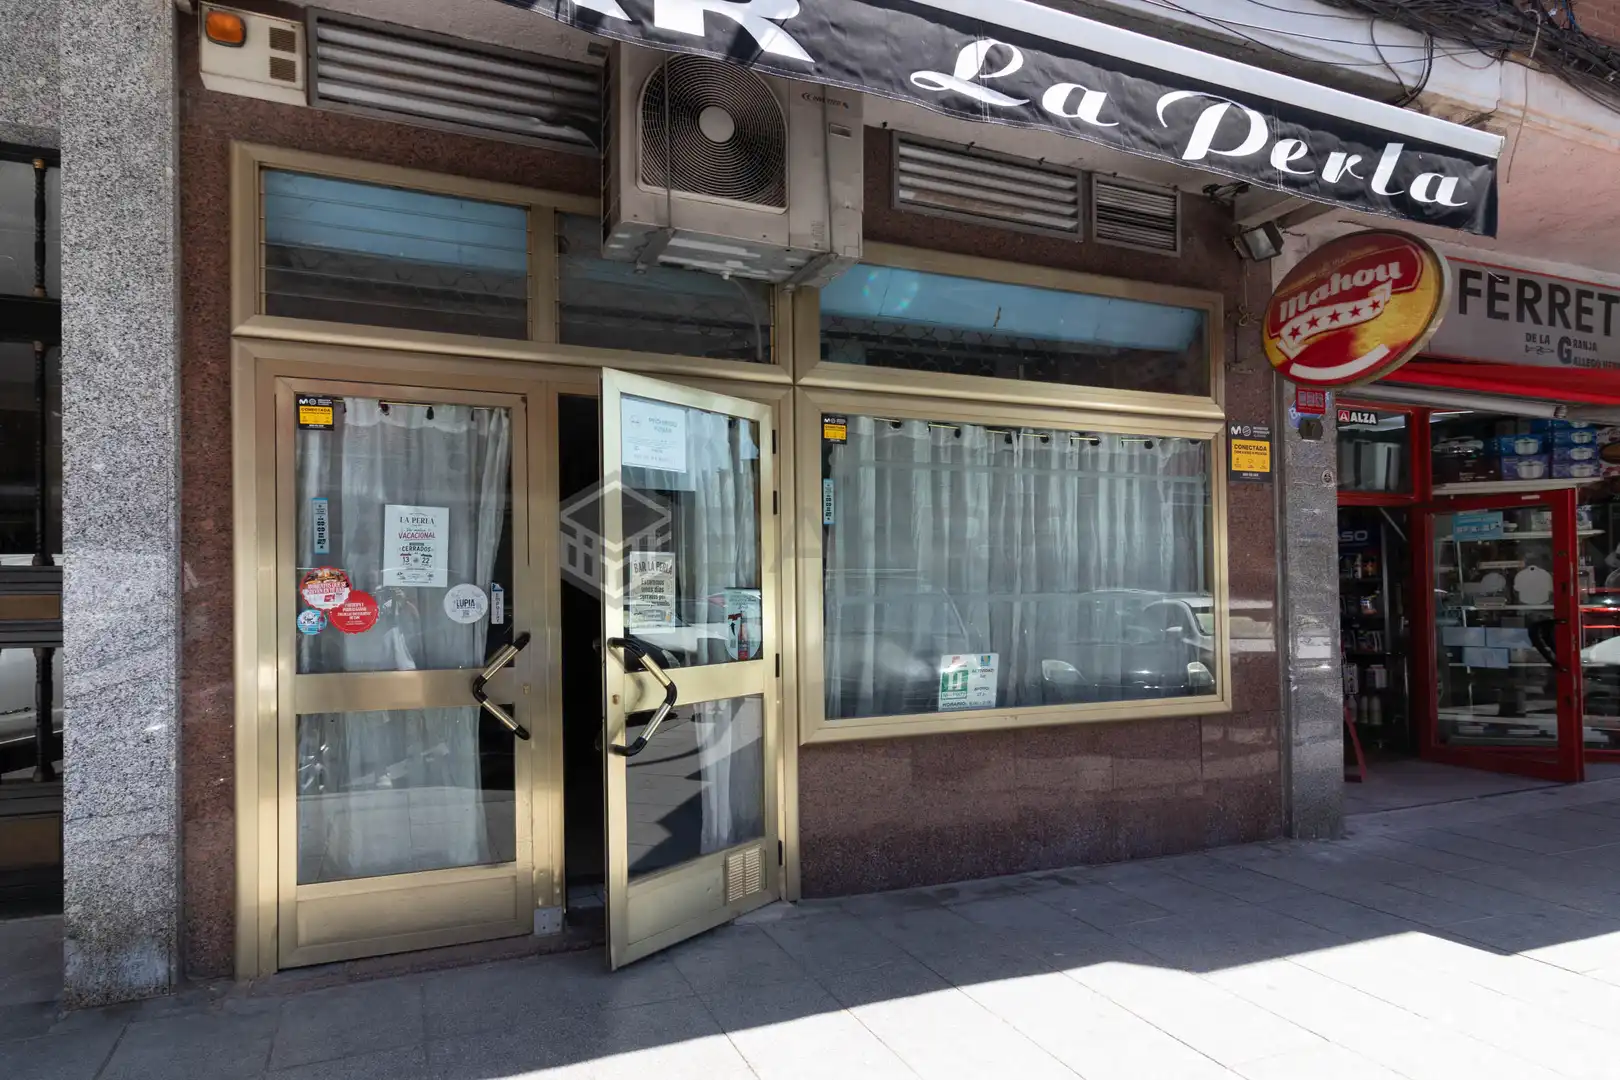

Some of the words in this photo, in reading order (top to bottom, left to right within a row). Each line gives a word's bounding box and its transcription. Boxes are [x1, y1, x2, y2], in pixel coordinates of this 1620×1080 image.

[910, 38, 1120, 127] La
[1156, 90, 1468, 207] Perla
[1279, 261, 1403, 323] Mahou
[1459, 268, 1620, 337] FERRET
[1525, 333, 1537, 343] DE
[1539, 334, 1550, 345] LA
[1350, 412, 1377, 424] ALZA
[1234, 444, 1267, 452] CONECTADA
[400, 516, 409, 524] LA
[412, 517, 435, 525] PERLA
[398, 531, 436, 539] VACACIONAL
[634, 561, 646, 573] BAR
[648, 560, 655, 572] LA
